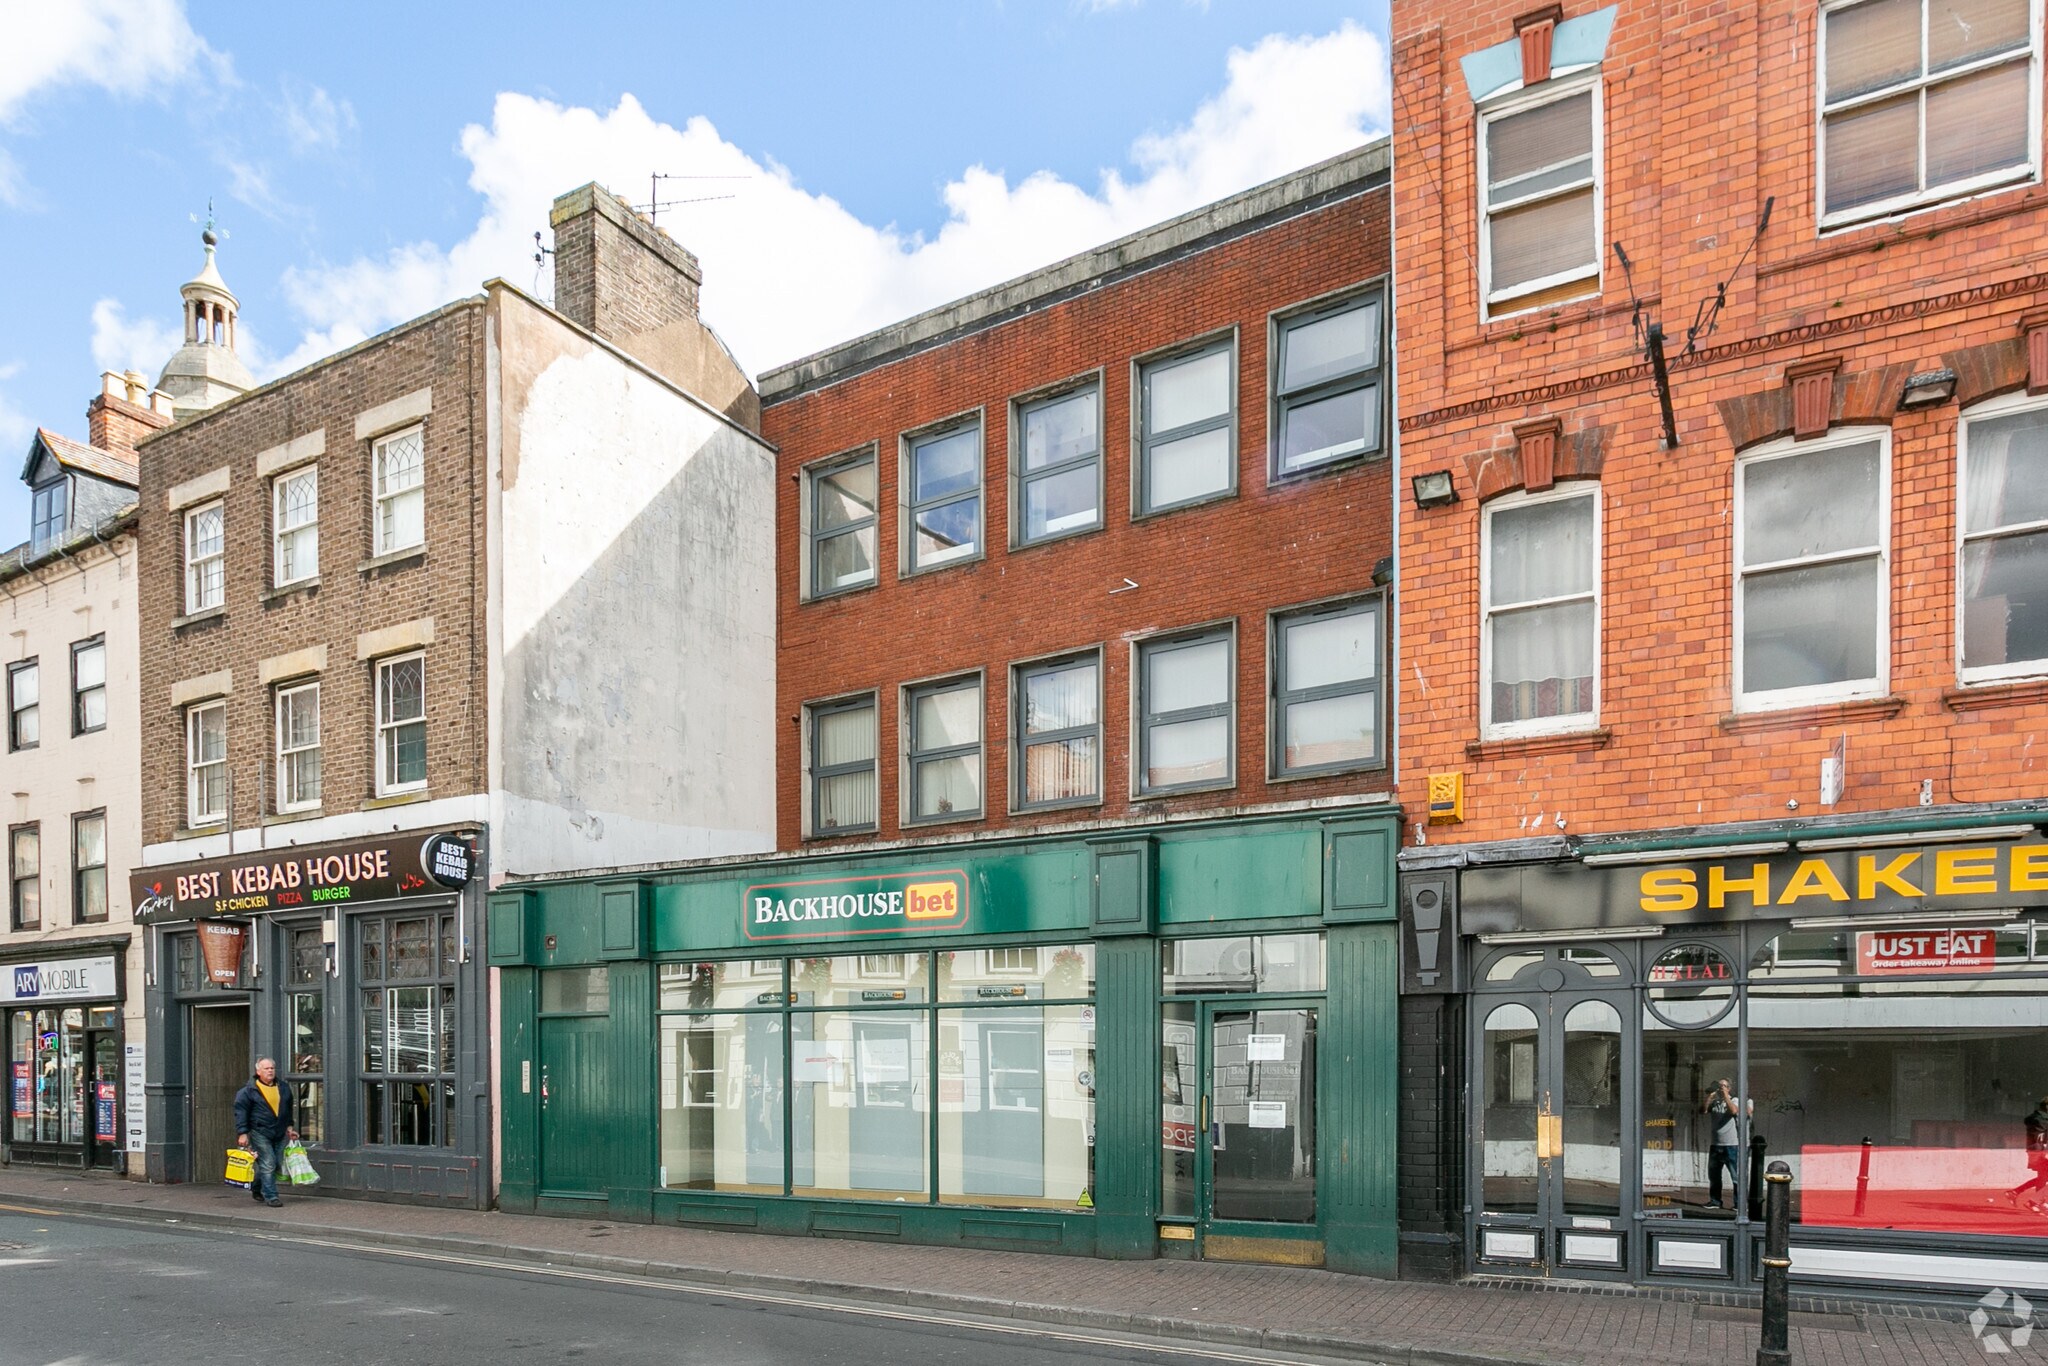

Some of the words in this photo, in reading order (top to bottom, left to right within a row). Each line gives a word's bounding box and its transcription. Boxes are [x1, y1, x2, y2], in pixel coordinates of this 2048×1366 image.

[440, 841, 466, 858] BEST
[435, 852, 468, 869] KEBAB
[176, 871, 221, 901] BEST
[231, 861, 302, 895] KEBAB
[306, 849, 390, 886] HOUSE
[435, 863, 467, 880] HOUSE
[401, 873, 425, 890] حلال
[228, 896, 269, 911] CHICKEN
[277, 892, 303, 905] PIZZA
[311, 886, 350, 902] BURGER
[909, 889, 955, 913] bet
[207, 925, 240, 935] KEBAB
[1865, 937, 1930, 957] JUST
[1934, 935, 1987, 955] EAT
[1653, 963, 1730, 980] HALAL
[1871, 959, 1899, 968] Order
[1900, 958, 1948, 968] takeaway
[1949, 958, 1981, 966] online
[16, 972, 39, 993] ARY
[39, 968, 89, 991] MOBILE
[214, 969, 236, 977] OPEN
[40, 1036, 58, 1050] OPEN
[1647, 1140, 1661, 1150] NO
[1663, 1140, 1673, 1150] ID
[1646, 1196, 1660, 1206] NO
[1662, 1195, 1672, 1206] ID
